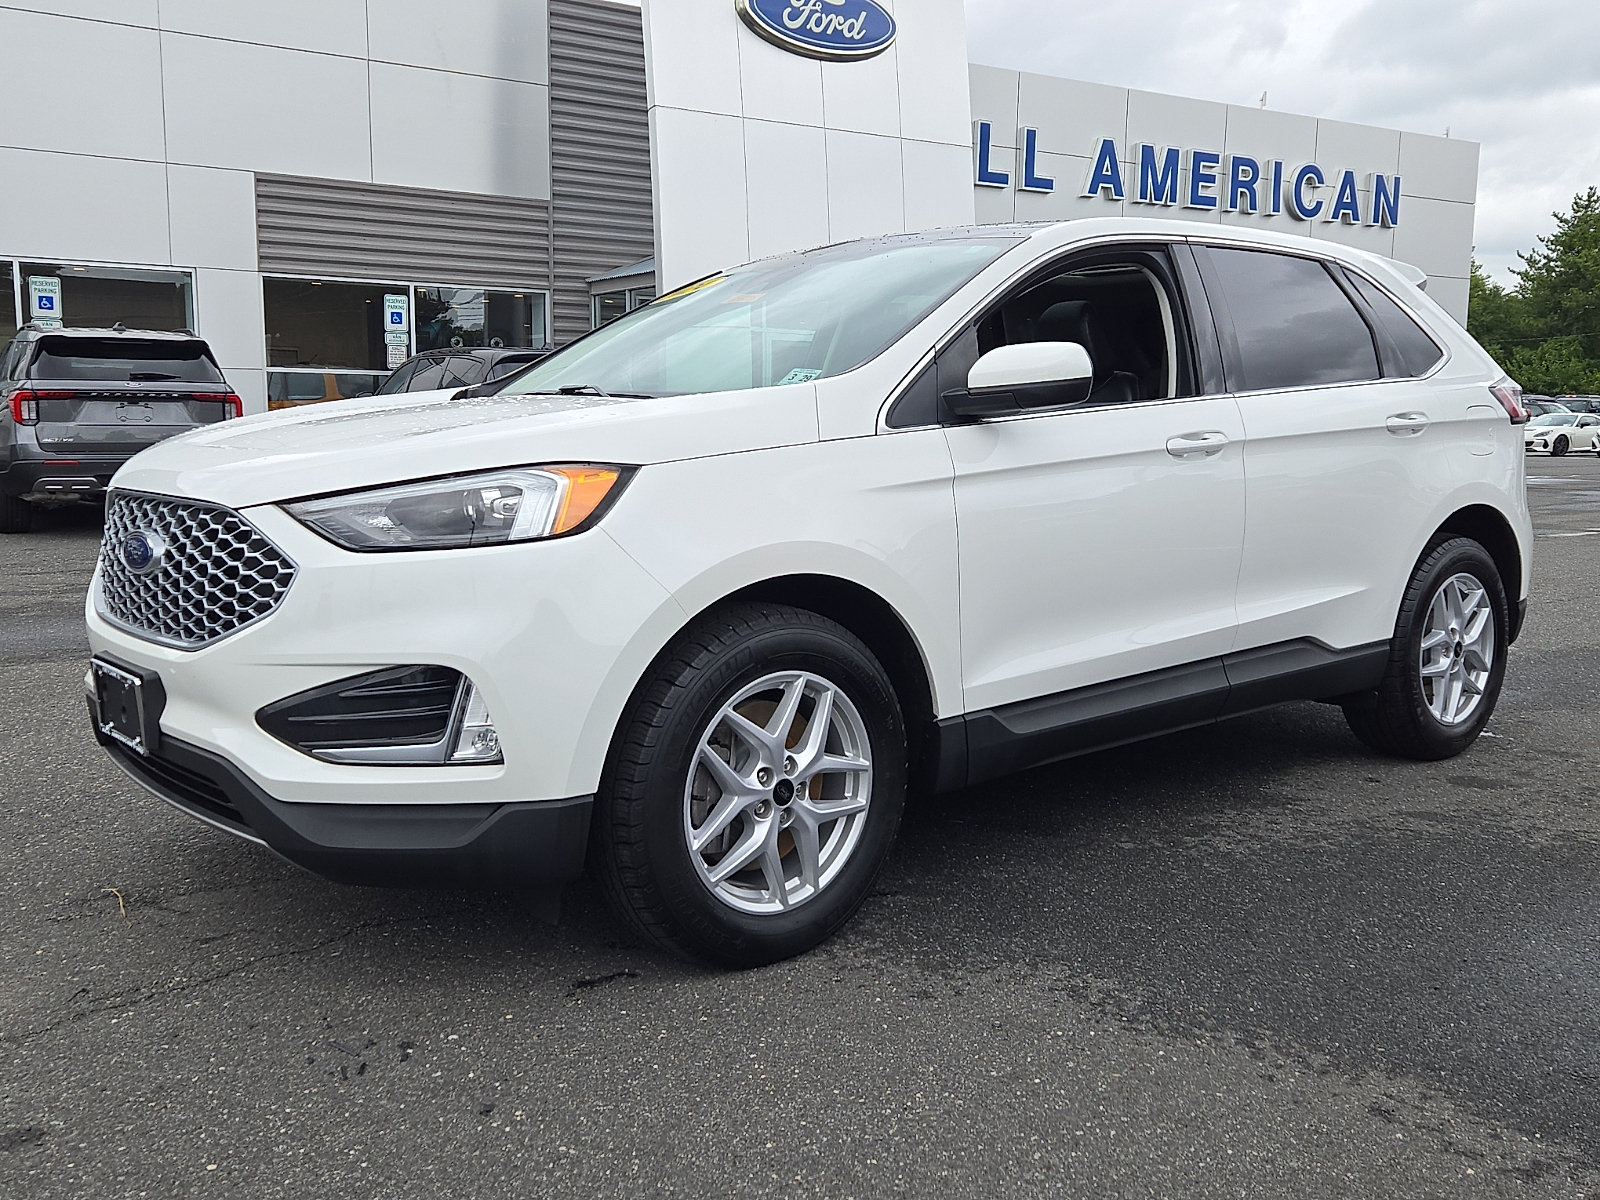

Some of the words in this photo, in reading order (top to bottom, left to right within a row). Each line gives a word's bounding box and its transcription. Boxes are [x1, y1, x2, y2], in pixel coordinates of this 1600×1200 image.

[782, 0, 868, 40] Ford
[975, 119, 1056, 194] LL
[1082, 136, 1402, 228] AMERICAN
